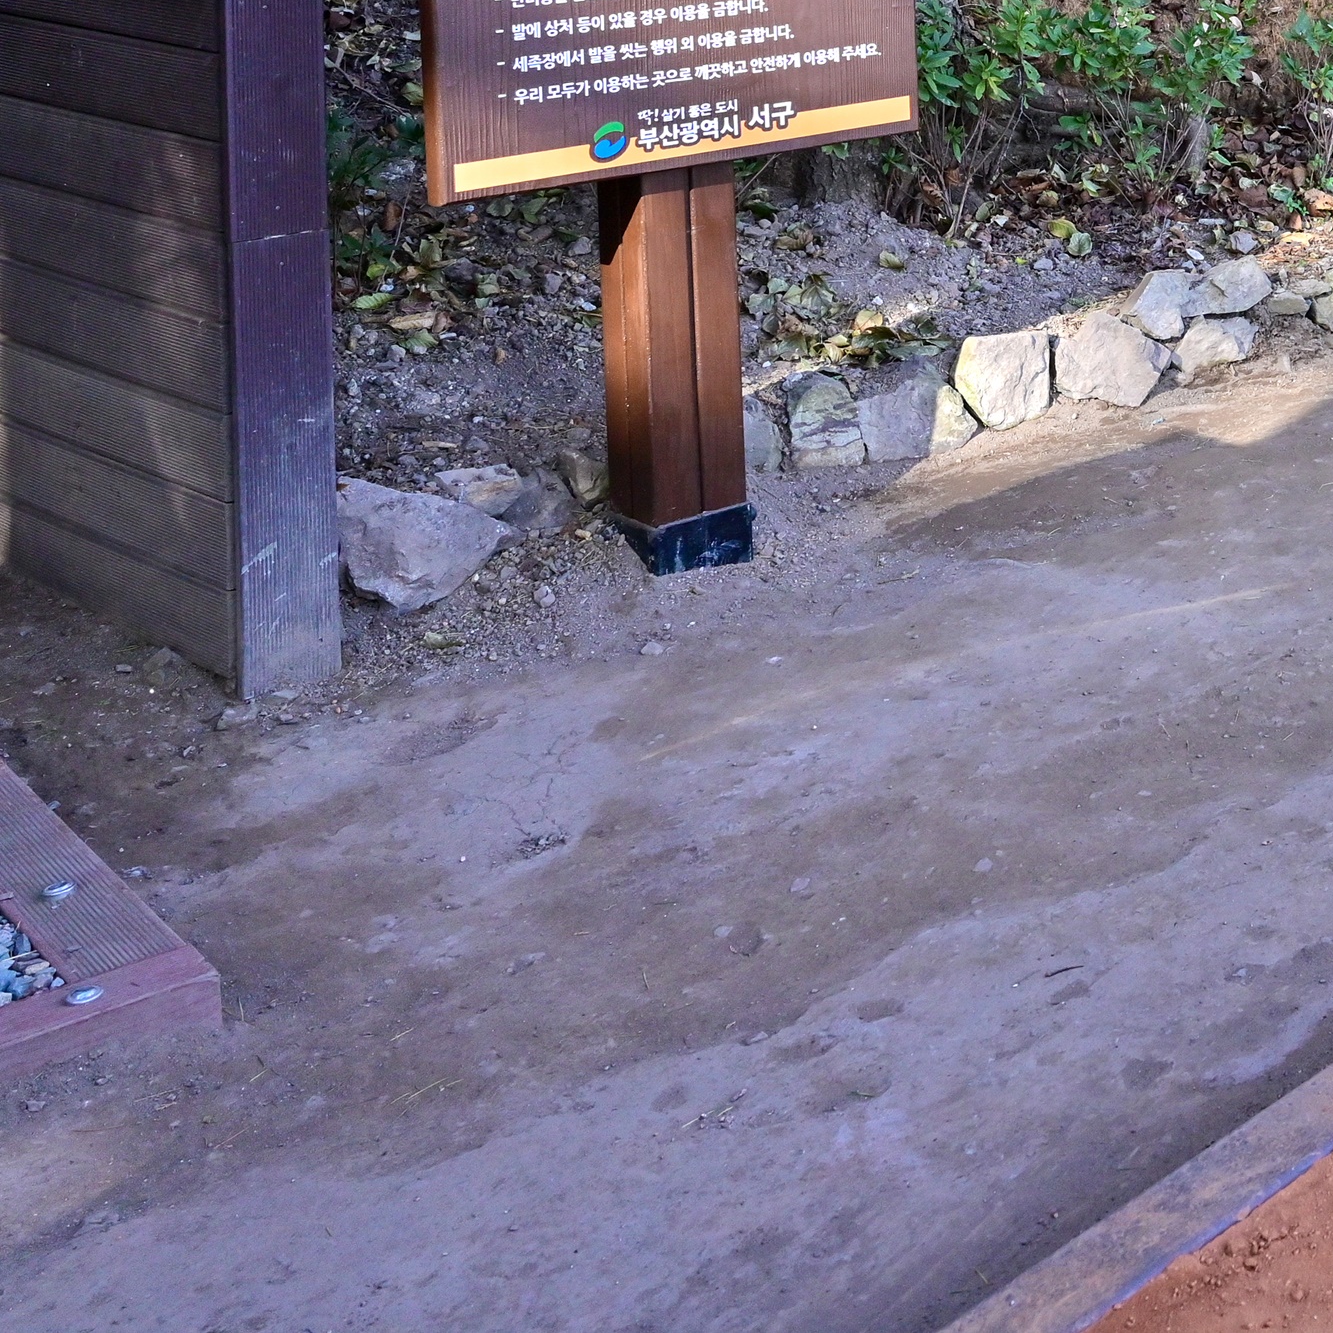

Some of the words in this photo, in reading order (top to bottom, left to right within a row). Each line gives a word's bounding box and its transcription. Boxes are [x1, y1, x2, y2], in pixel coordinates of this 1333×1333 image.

[512, 21, 541, 41] 발에
[544, 18, 574, 37] 상처
[576, 15, 605, 33] 등이
[608, 11, 636, 30] 있을
[640, 7, 668, 26] 경우
[670, 2, 710, 22] 이용을
[513, 48, 585, 72] 세족장에서
[588, 45, 617, 63] 발을
[619, 41, 648, 60] 씻는
[650, 37, 678, 56] 행위
[680, 35, 694, 52] 외
[697, 30, 737, 49] 이용을
[739, 24, 795, 44] 금합니다.
[514, 86, 543, 105] 우리
[546, 79, 591, 100] 모두가
[593, 74, 650, 94] 이용하는
[651, 67, 693, 87] 곳으로
[695, 60, 748, 80] 깨끗하고
[750, 52, 801, 73] 안전하게
[803, 47, 840, 65] 이용해
[842, 43, 882, 59] 주세요.
[637, 108, 659, 126] 딱!
[661, 106, 685, 122] 살기
[688, 103, 712, 118] 좋은
[715, 98, 738, 114] 도시
[637, 114, 739, 150] 부산광역시
[748, 101, 795, 129] 서구
